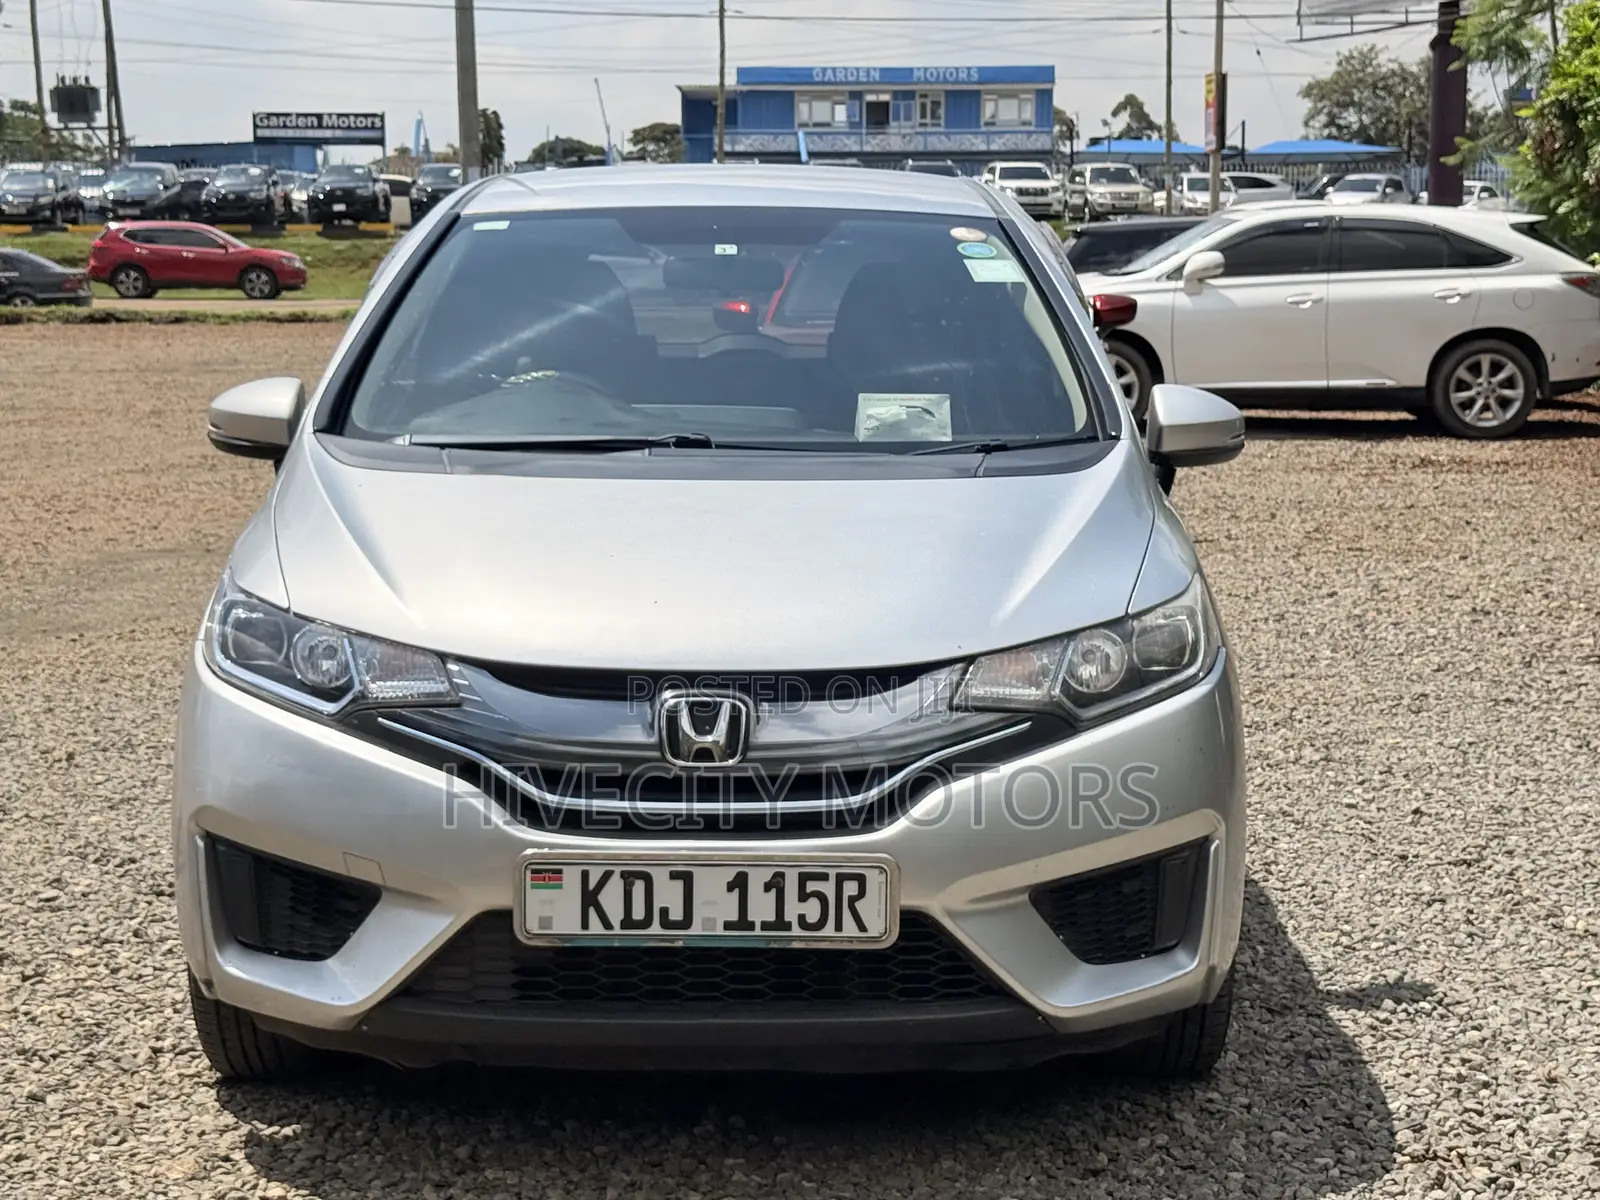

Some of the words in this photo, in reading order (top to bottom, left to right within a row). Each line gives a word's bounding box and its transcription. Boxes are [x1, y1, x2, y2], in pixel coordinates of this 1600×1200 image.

[812, 67, 881, 82] GARDEN
[912, 67, 980, 82] MOTORS
[255, 113, 318, 128] Garden
[322, 114, 382, 128] Motors
[580, 869, 694, 931] KDJ
[723, 870, 869, 932] 115R
